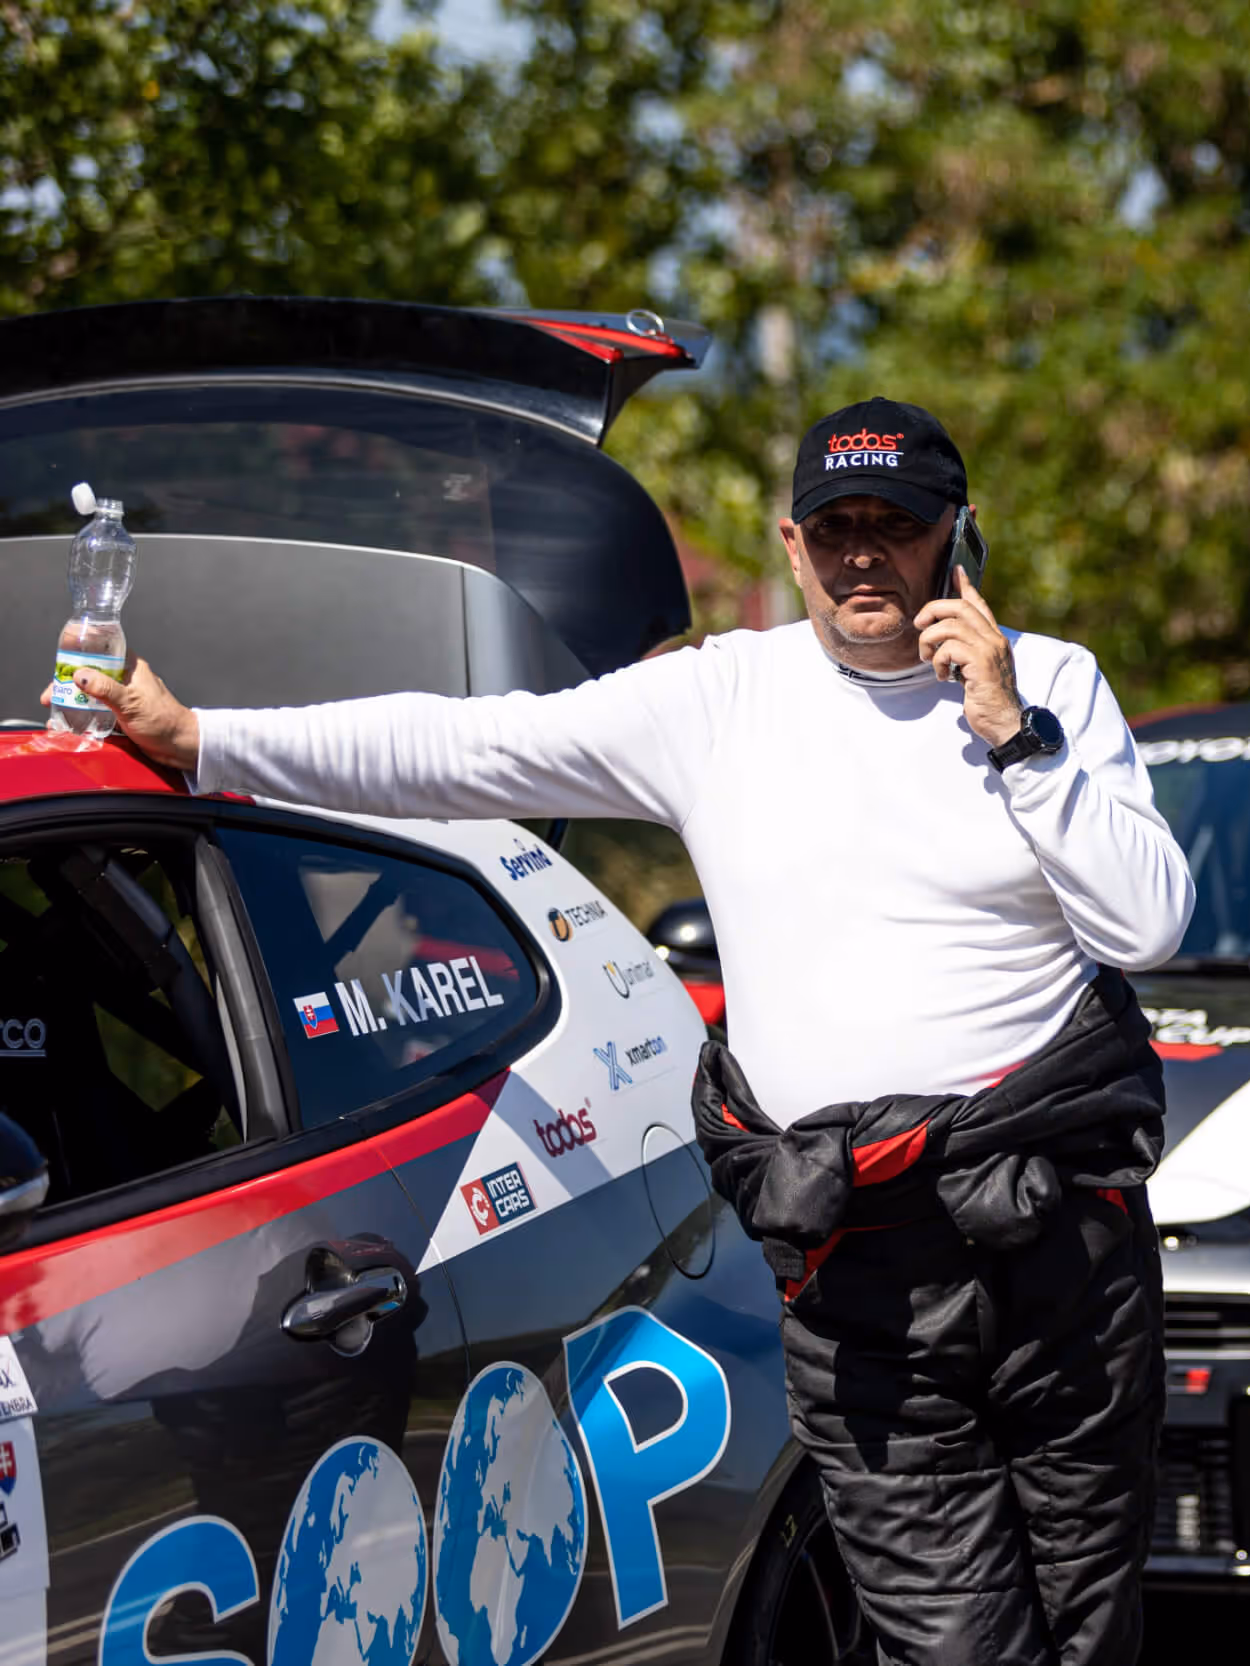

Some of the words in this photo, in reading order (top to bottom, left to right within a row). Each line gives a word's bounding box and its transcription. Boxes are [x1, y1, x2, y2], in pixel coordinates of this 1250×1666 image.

[828, 428, 898, 452] todos
[825, 452, 899, 472] RACING
[334, 978, 388, 1037] M.
[381, 955, 505, 1026] KAREL
[0, 1018, 47, 1050] CO
[533, 1108, 597, 1158] todos
[486, 1169, 523, 1199] INTER
[494, 1188, 531, 1218] CARS
